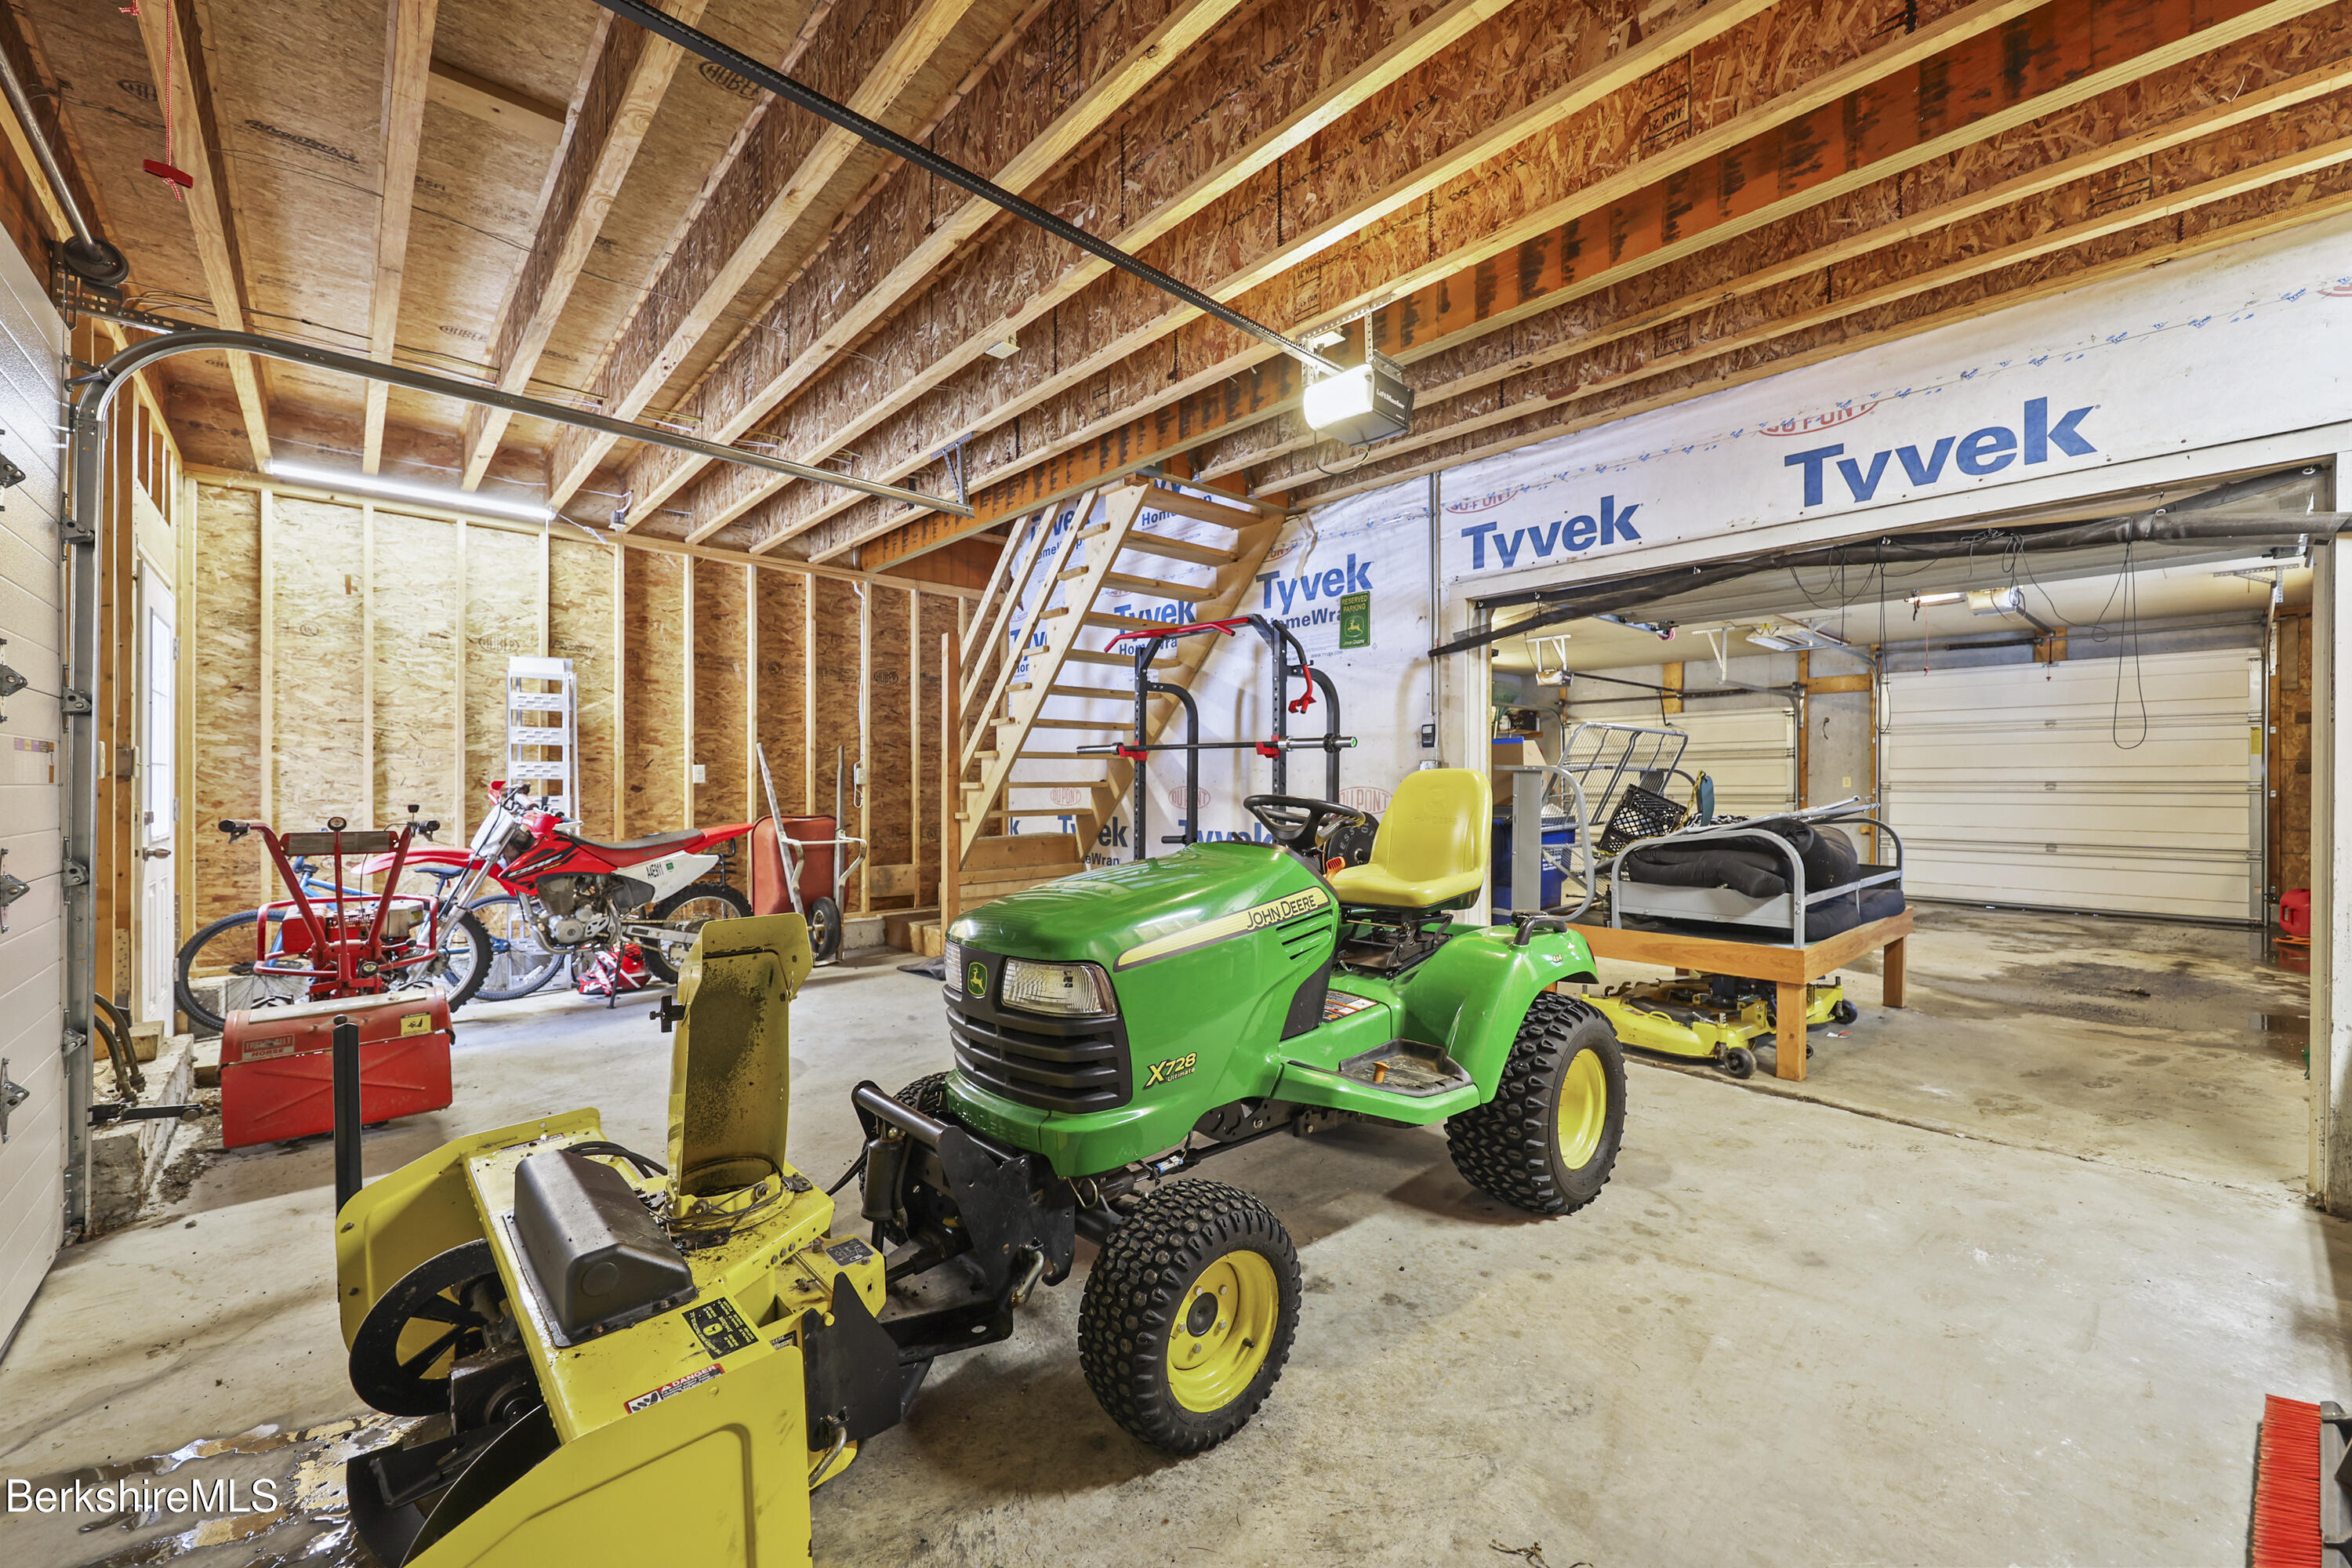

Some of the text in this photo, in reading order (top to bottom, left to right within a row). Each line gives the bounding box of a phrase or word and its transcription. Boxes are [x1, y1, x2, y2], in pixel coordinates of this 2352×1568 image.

[1261, 42, 1295, 74] 230
[1663, 107, 1683, 126] JAN
[1359, 119, 1399, 147] 230
[1448, 178, 1486, 203] 230
[1376, 388, 1406, 410] LiftMaster
[1784, 396, 2098, 507] Tyvek
[1461, 495, 1642, 570] Tyvek
[1256, 553, 1374, 615] Tyvek
[1341, 595, 1368, 605] RESERVED
[1343, 604, 1366, 613] PARKING
[1247, 895, 1316, 928] JOHN DEERE
[251, 1047, 285, 1058] HORSE
[1145, 1051, 1197, 1087] X728
[1167, 1067, 1196, 1082] Ultimate
[672, 1365, 717, 1387] DANGER
